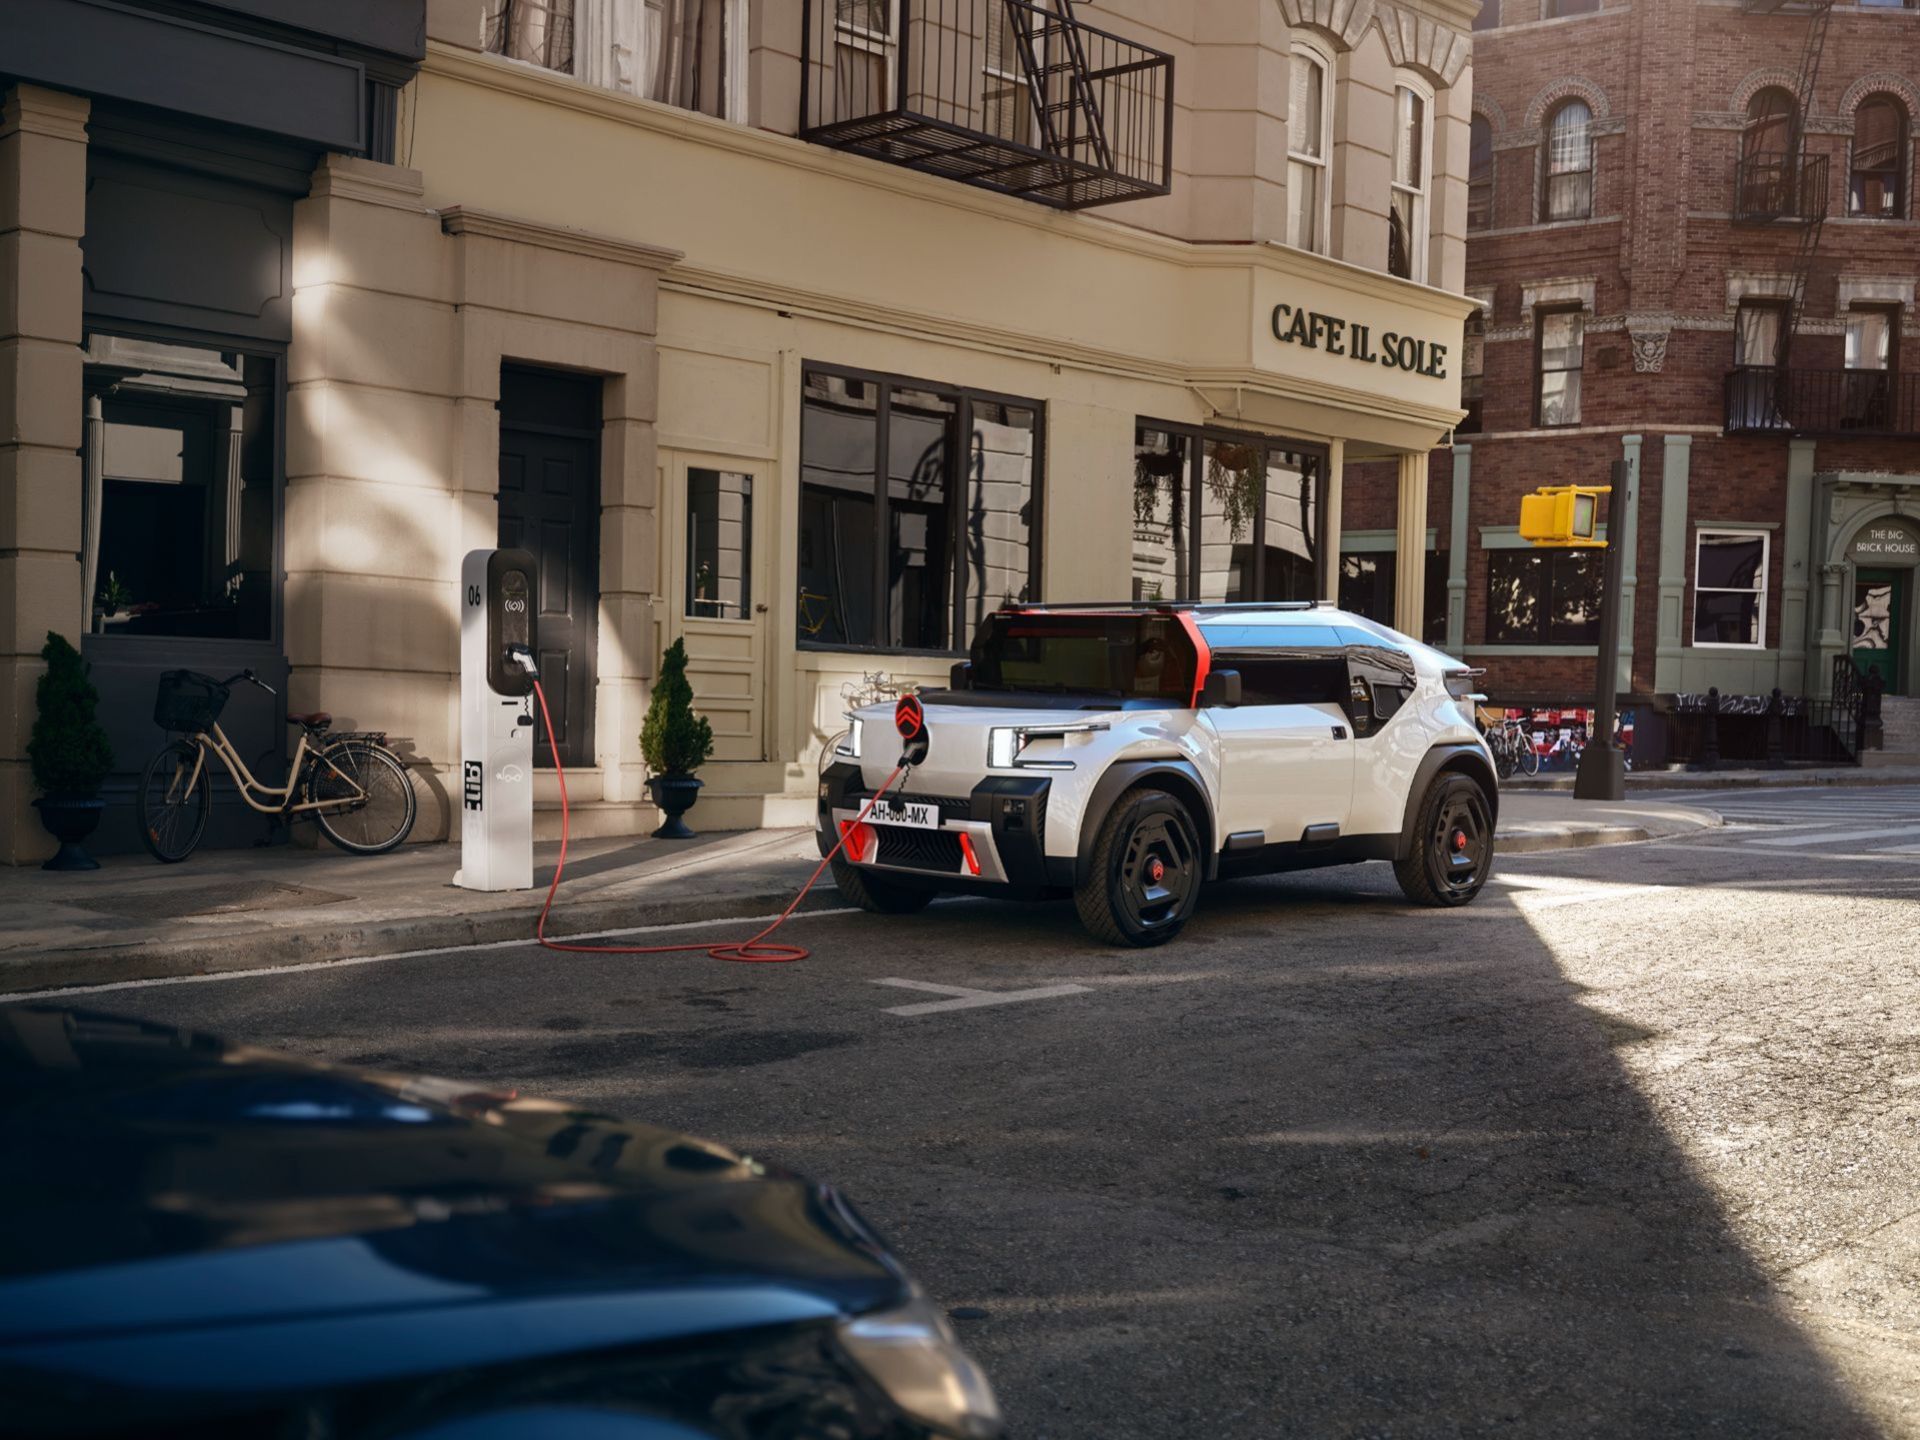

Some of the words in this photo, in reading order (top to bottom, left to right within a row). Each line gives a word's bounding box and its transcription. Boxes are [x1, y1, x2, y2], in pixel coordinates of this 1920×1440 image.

[1272, 303, 1345, 355] CAFE
[1350, 323, 1376, 363] IL
[1382, 332, 1447, 379] SOLE
[1871, 530, 1885, 540] THE
[1888, 530, 1903, 540] BIG
[1857, 543, 1881, 552] BRICK
[1885, 543, 1915, 553] HOUSE
[468, 585, 481, 607] 06
